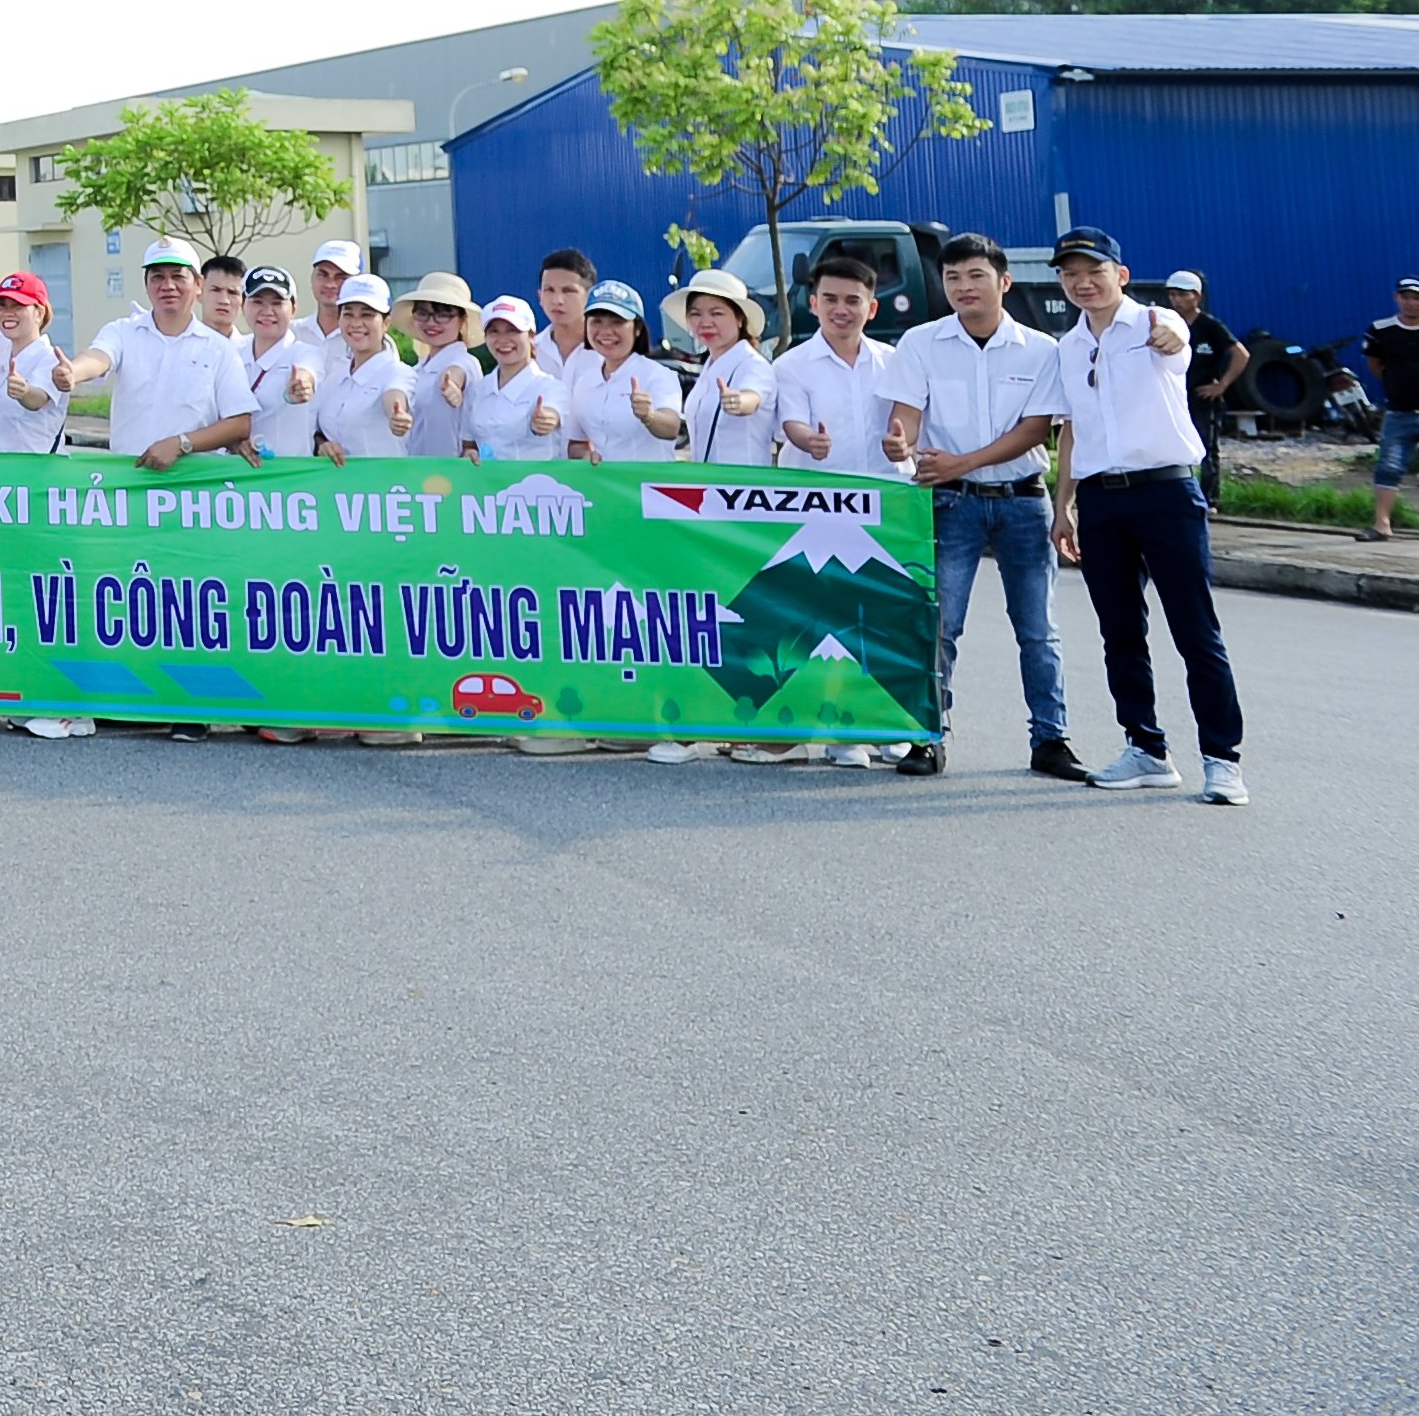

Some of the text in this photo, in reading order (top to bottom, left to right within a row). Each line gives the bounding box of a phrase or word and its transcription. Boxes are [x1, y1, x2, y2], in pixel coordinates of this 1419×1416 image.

[47, 472, 129, 528] HẢI
[147, 480, 318, 533] PHÒNG
[334, 485, 442, 543] VIỆT
[461, 491, 585, 537] NAM
[717, 487, 871, 515] YAZAKI
[30, 558, 78, 646] VÌ
[93, 560, 229, 650] CÔNG
[243, 564, 388, 656] ĐOÀN
[400, 565, 541, 661] VỮNG
[558, 589, 723, 682] MẠNH
